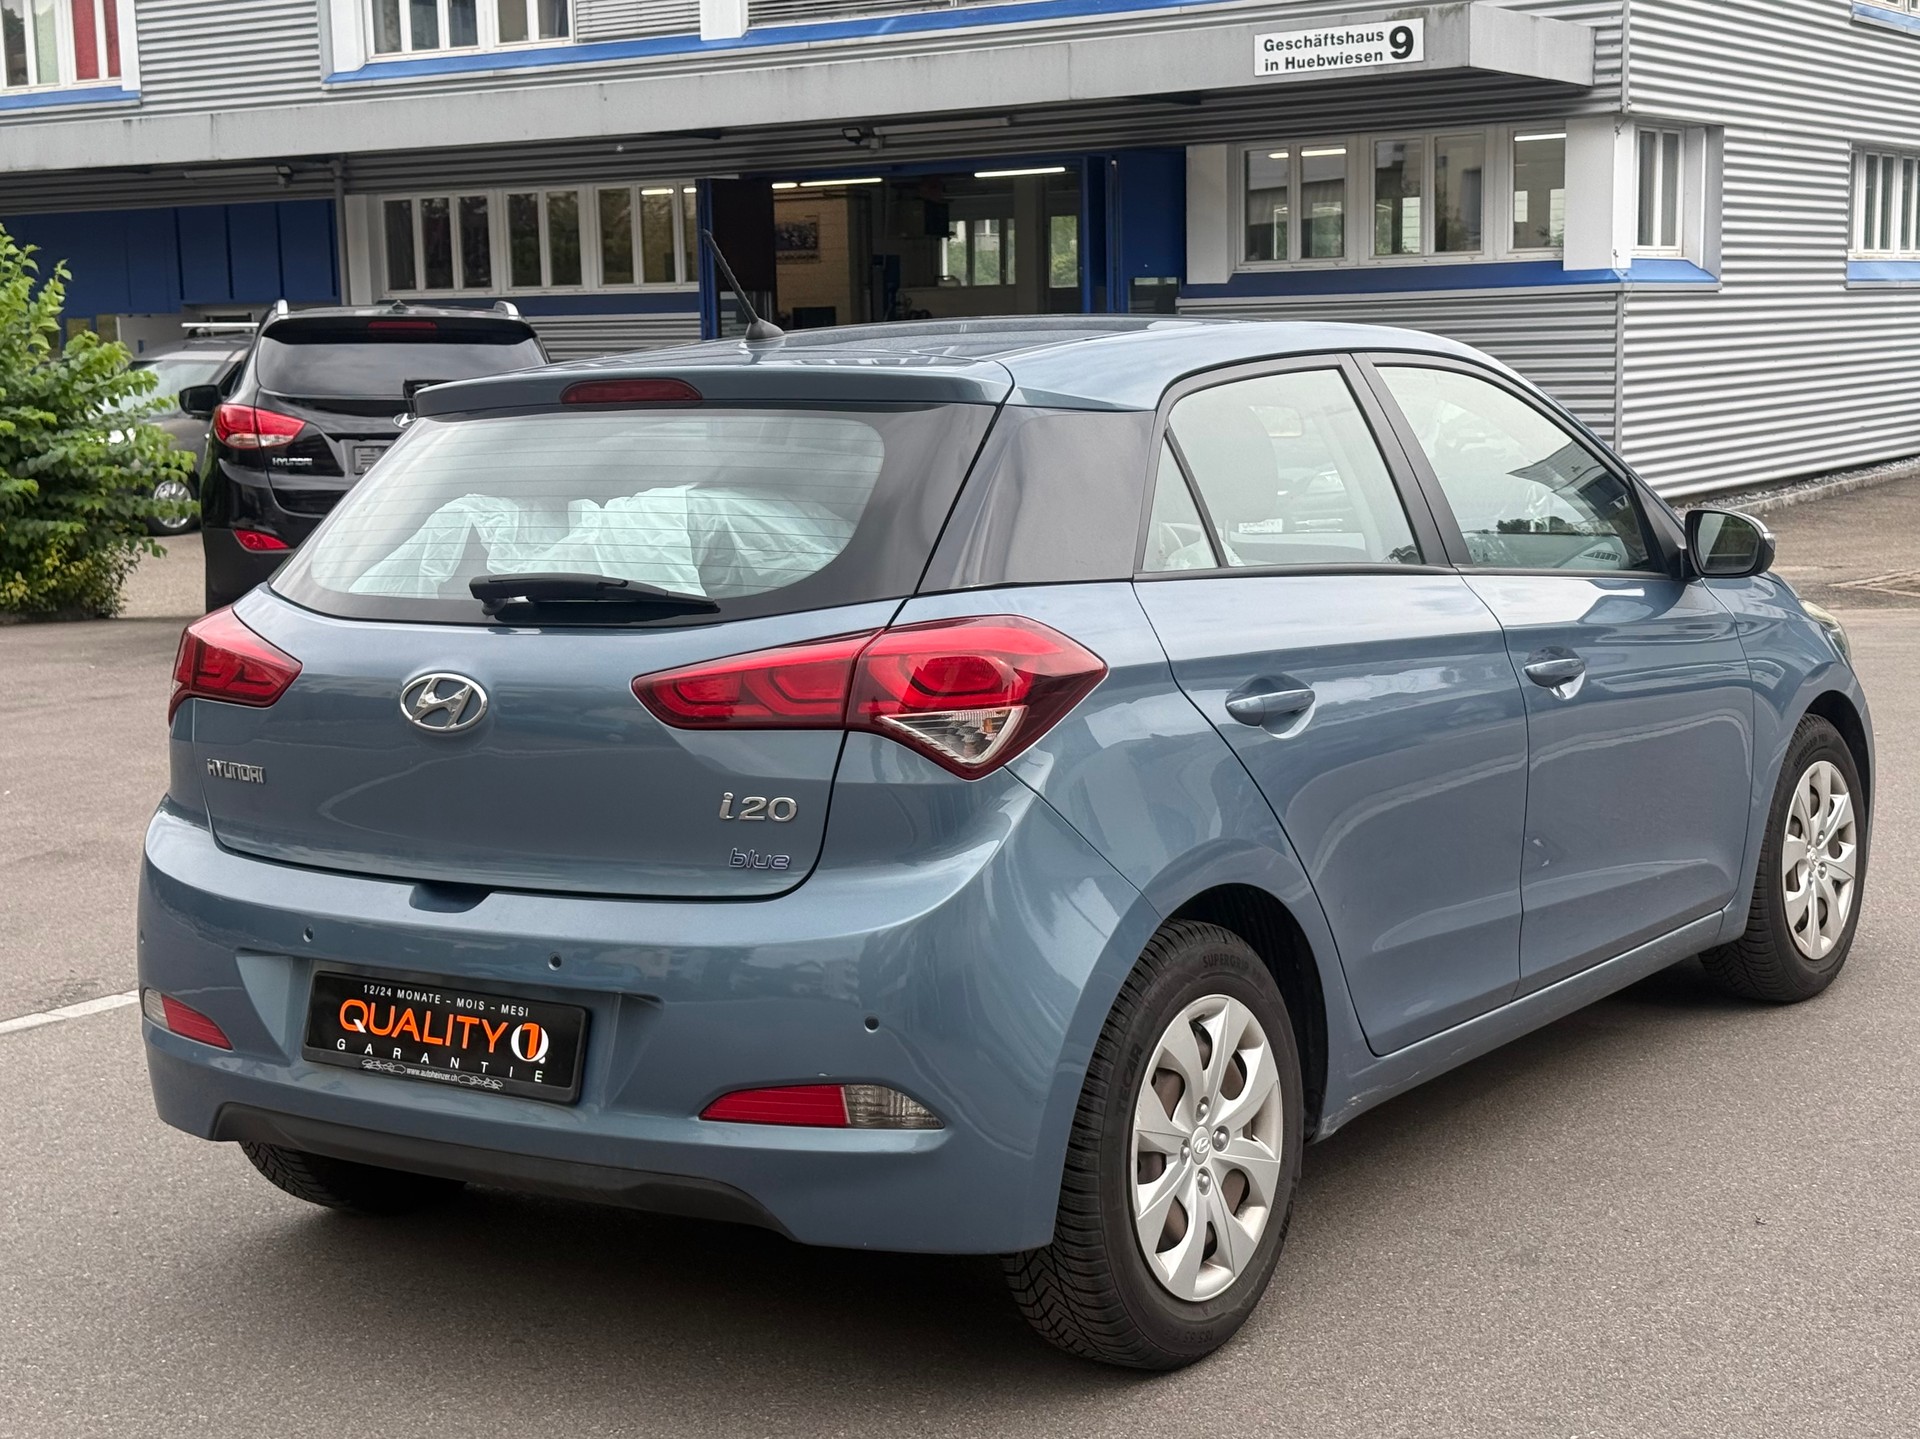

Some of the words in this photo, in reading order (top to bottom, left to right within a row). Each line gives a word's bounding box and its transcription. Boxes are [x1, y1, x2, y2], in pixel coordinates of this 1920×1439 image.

[1264, 31, 1384, 52] Geschäftshaus
[1389, 25, 1414, 60] 9
[1264, 58, 1279, 72] in
[1285, 51, 1383, 70] Huebwiesen
[206, 758, 264, 784] HYUNDAI
[719, 791, 798, 822] i20
[729, 847, 790, 870] blue
[1202, 953, 1249, 970] SUPERGRIP
[363, 984, 392, 997] 12/24
[397, 989, 441, 1004] MONATE
[456, 997, 485, 1011] MOIS
[501, 1004, 529, 1017] MESI
[339, 999, 509, 1053] QUALITY
[336, 1038, 544, 1083] GARANTIE
